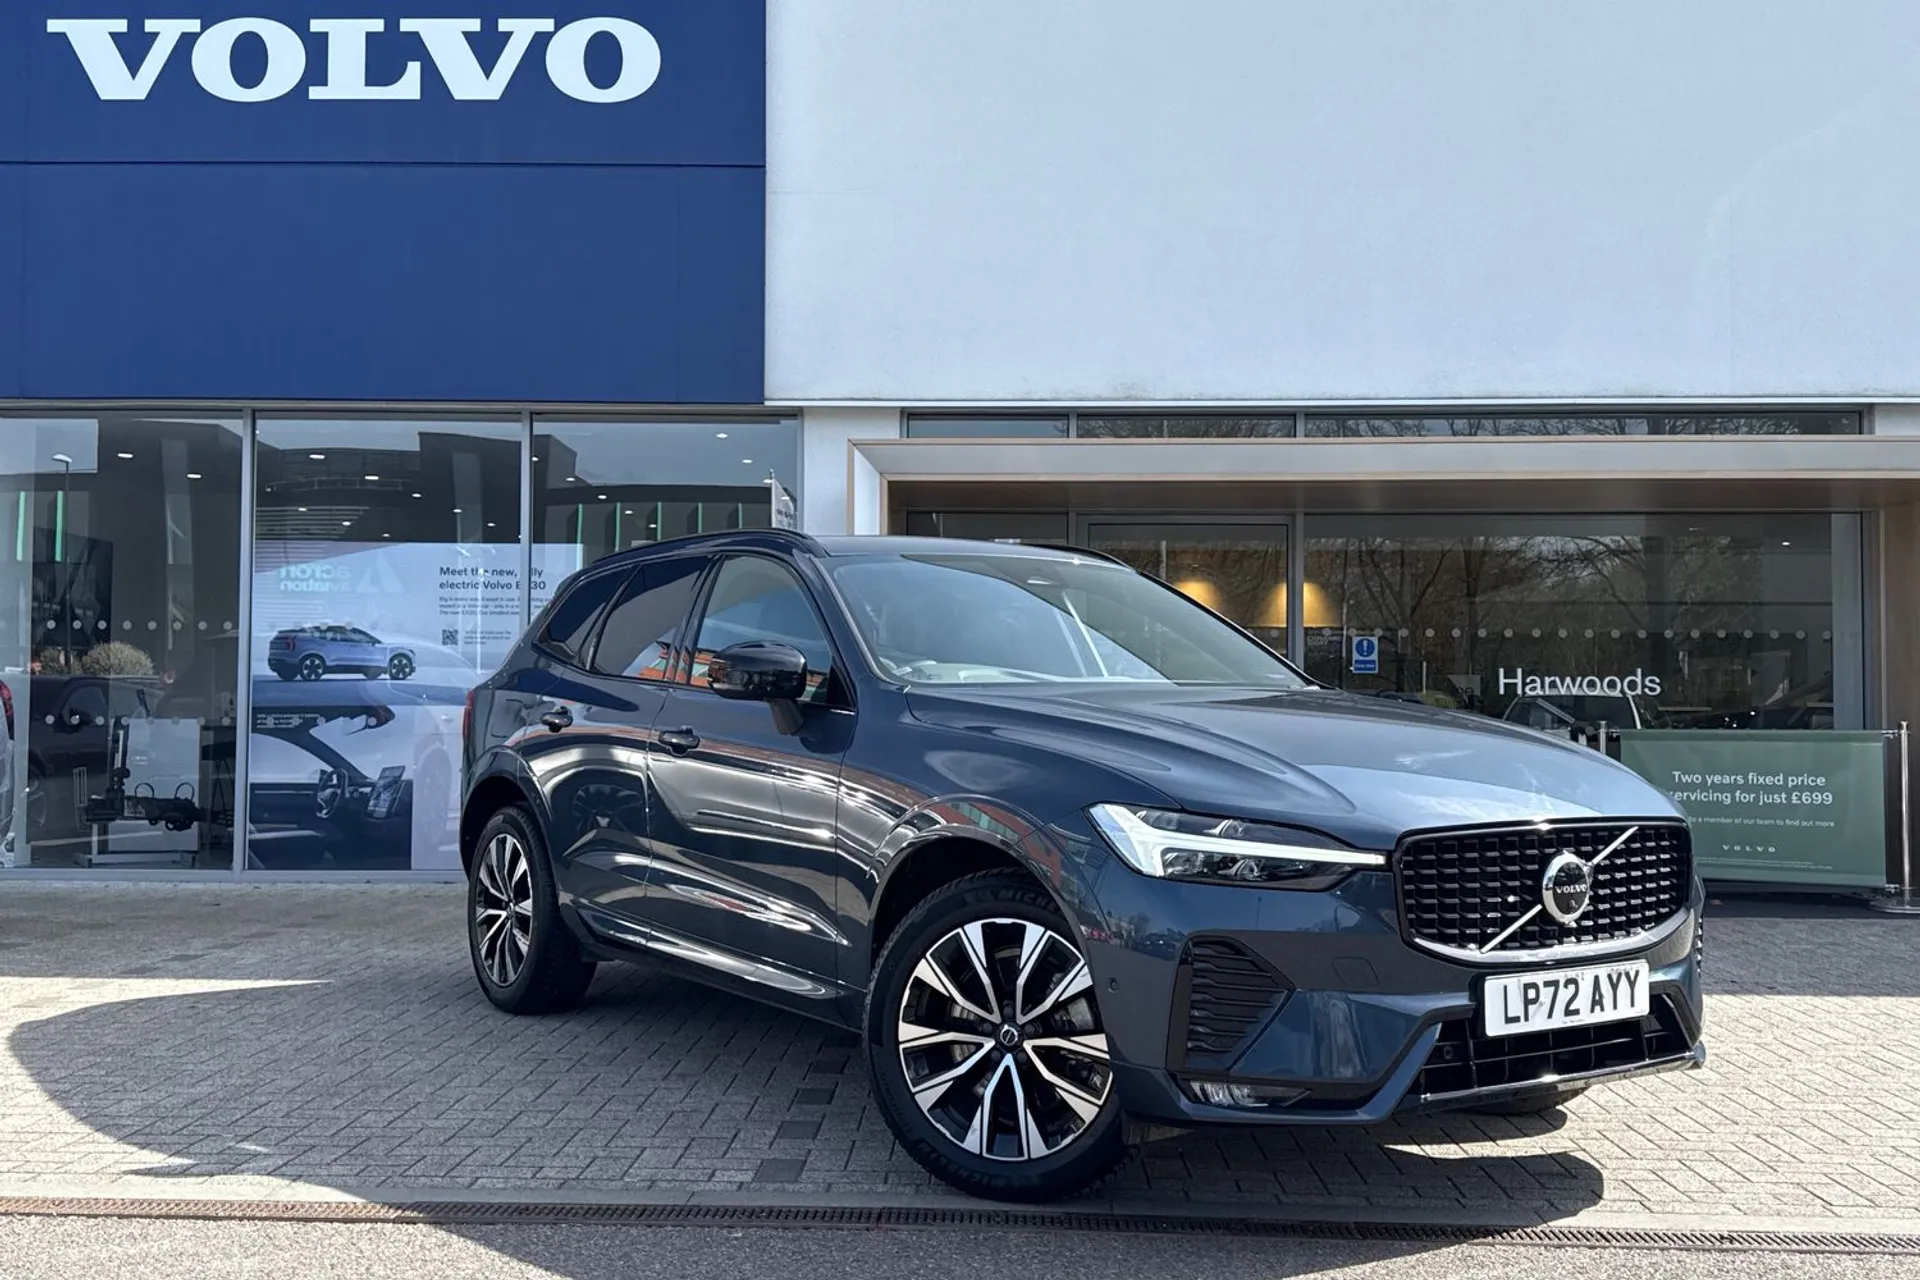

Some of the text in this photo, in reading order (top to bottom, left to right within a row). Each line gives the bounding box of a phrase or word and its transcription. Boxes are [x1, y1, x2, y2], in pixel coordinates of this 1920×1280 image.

[47, 17, 661, 102] VOLVO
[440, 567, 468, 576] Meet
[491, 569, 518, 577] new,
[439, 581, 546, 590] electric Volvo E30
[1498, 668, 1662, 696] Harwoods
[1672, 771, 1826, 788] Two years fixed price
[1669, 789, 1833, 805] ervicing for just £699
[1704, 816, 1733, 824] member
[1785, 819, 1800, 827] find
[1722, 844, 1776, 852] VOLVO
[1555, 884, 1587, 893] VOLVO
[1503, 969, 1640, 1024] LP72 AYY
